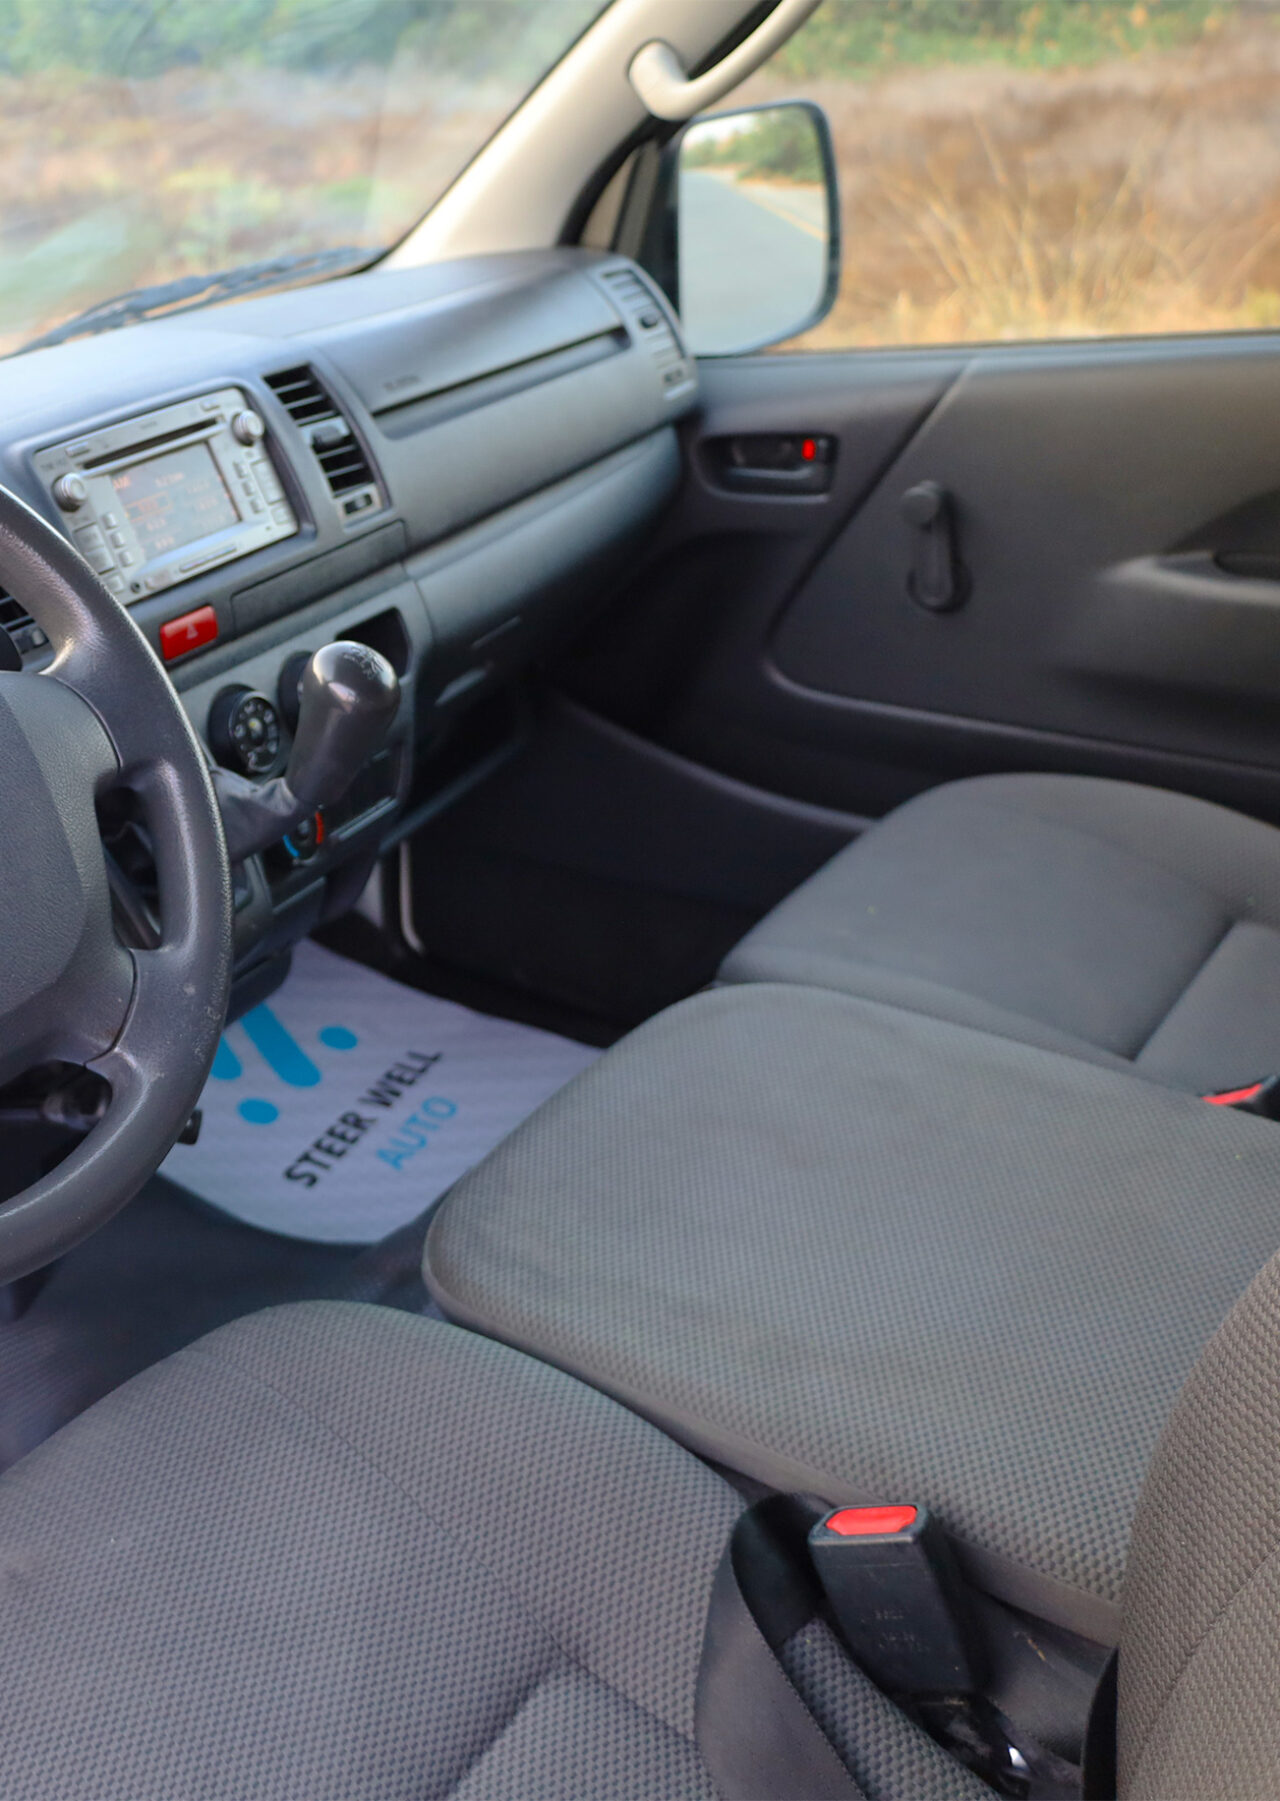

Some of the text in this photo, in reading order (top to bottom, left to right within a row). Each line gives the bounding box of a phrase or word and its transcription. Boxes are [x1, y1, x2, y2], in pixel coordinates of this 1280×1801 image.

[284, 1050, 442, 1188] STEER WELL
[376, 1096, 458, 1171] AUTO
